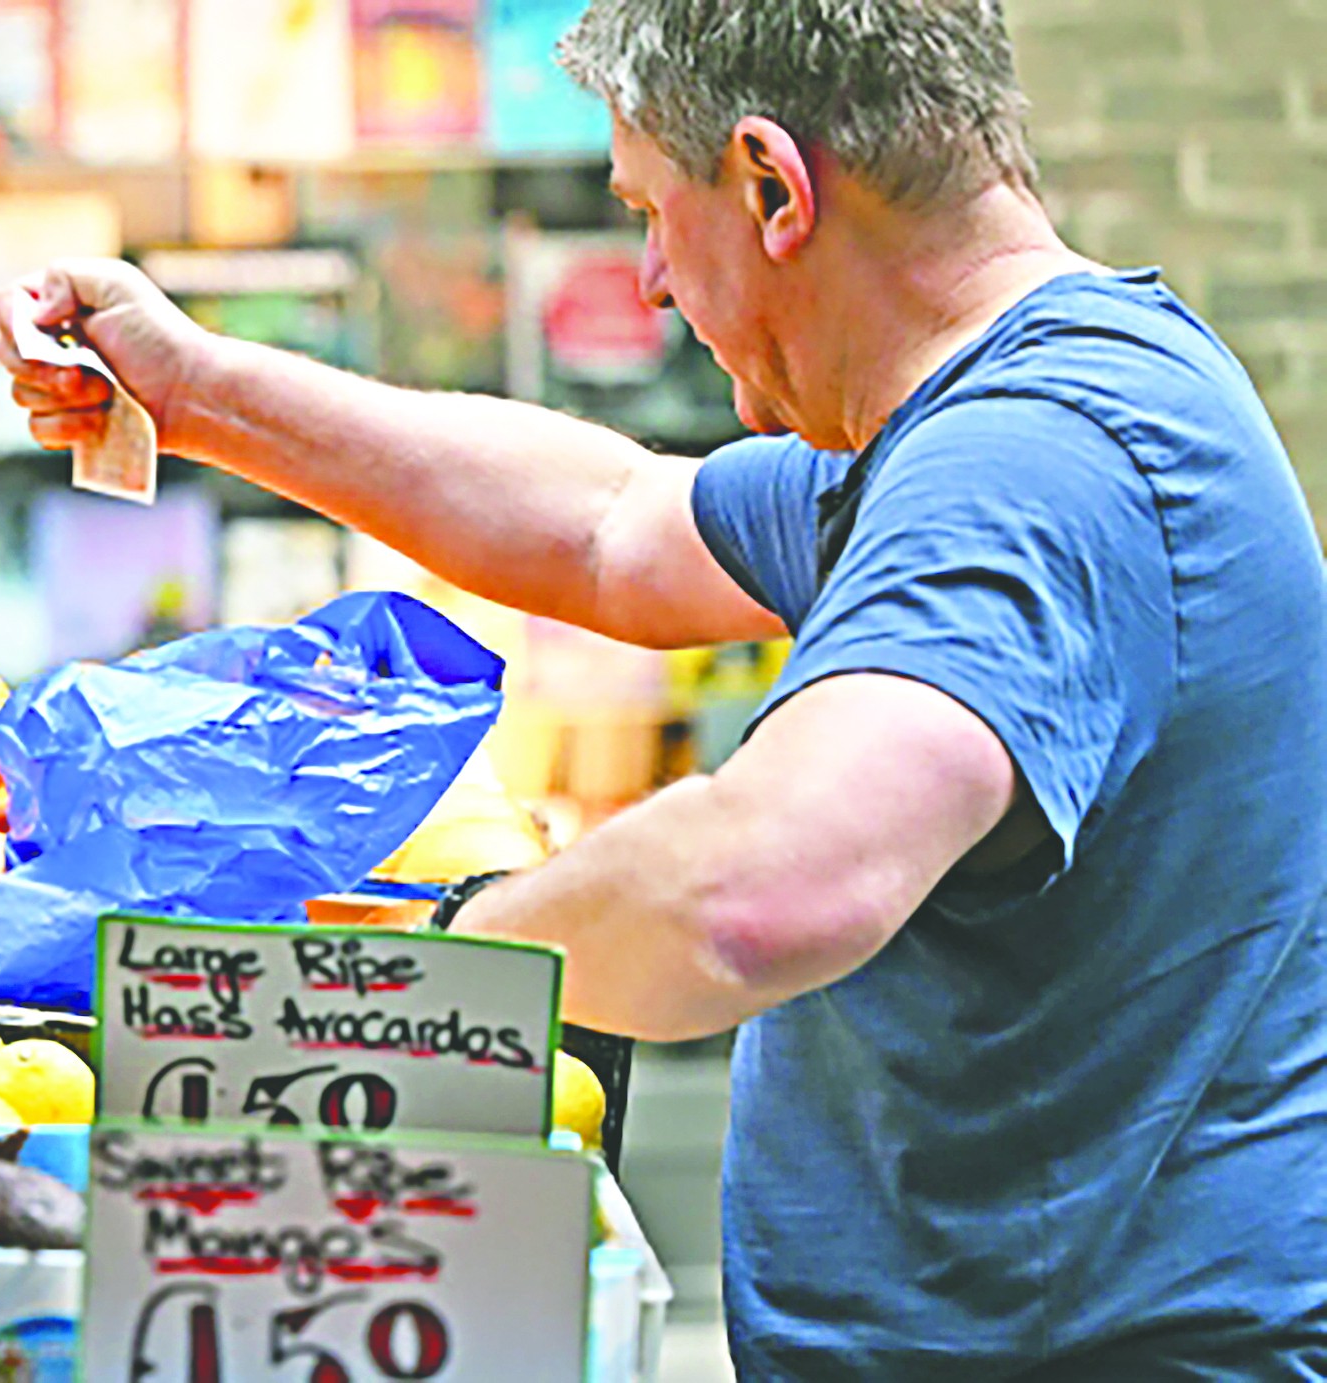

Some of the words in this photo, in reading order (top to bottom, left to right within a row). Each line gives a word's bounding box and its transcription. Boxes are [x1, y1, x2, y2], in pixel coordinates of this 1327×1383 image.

[119, 928, 264, 1013] Large
[293, 939, 425, 997] Ripe
[124, 984, 252, 1039] Hass
[276, 998, 534, 1068] Avocardos
[95, 1130, 285, 1190] Sweet
